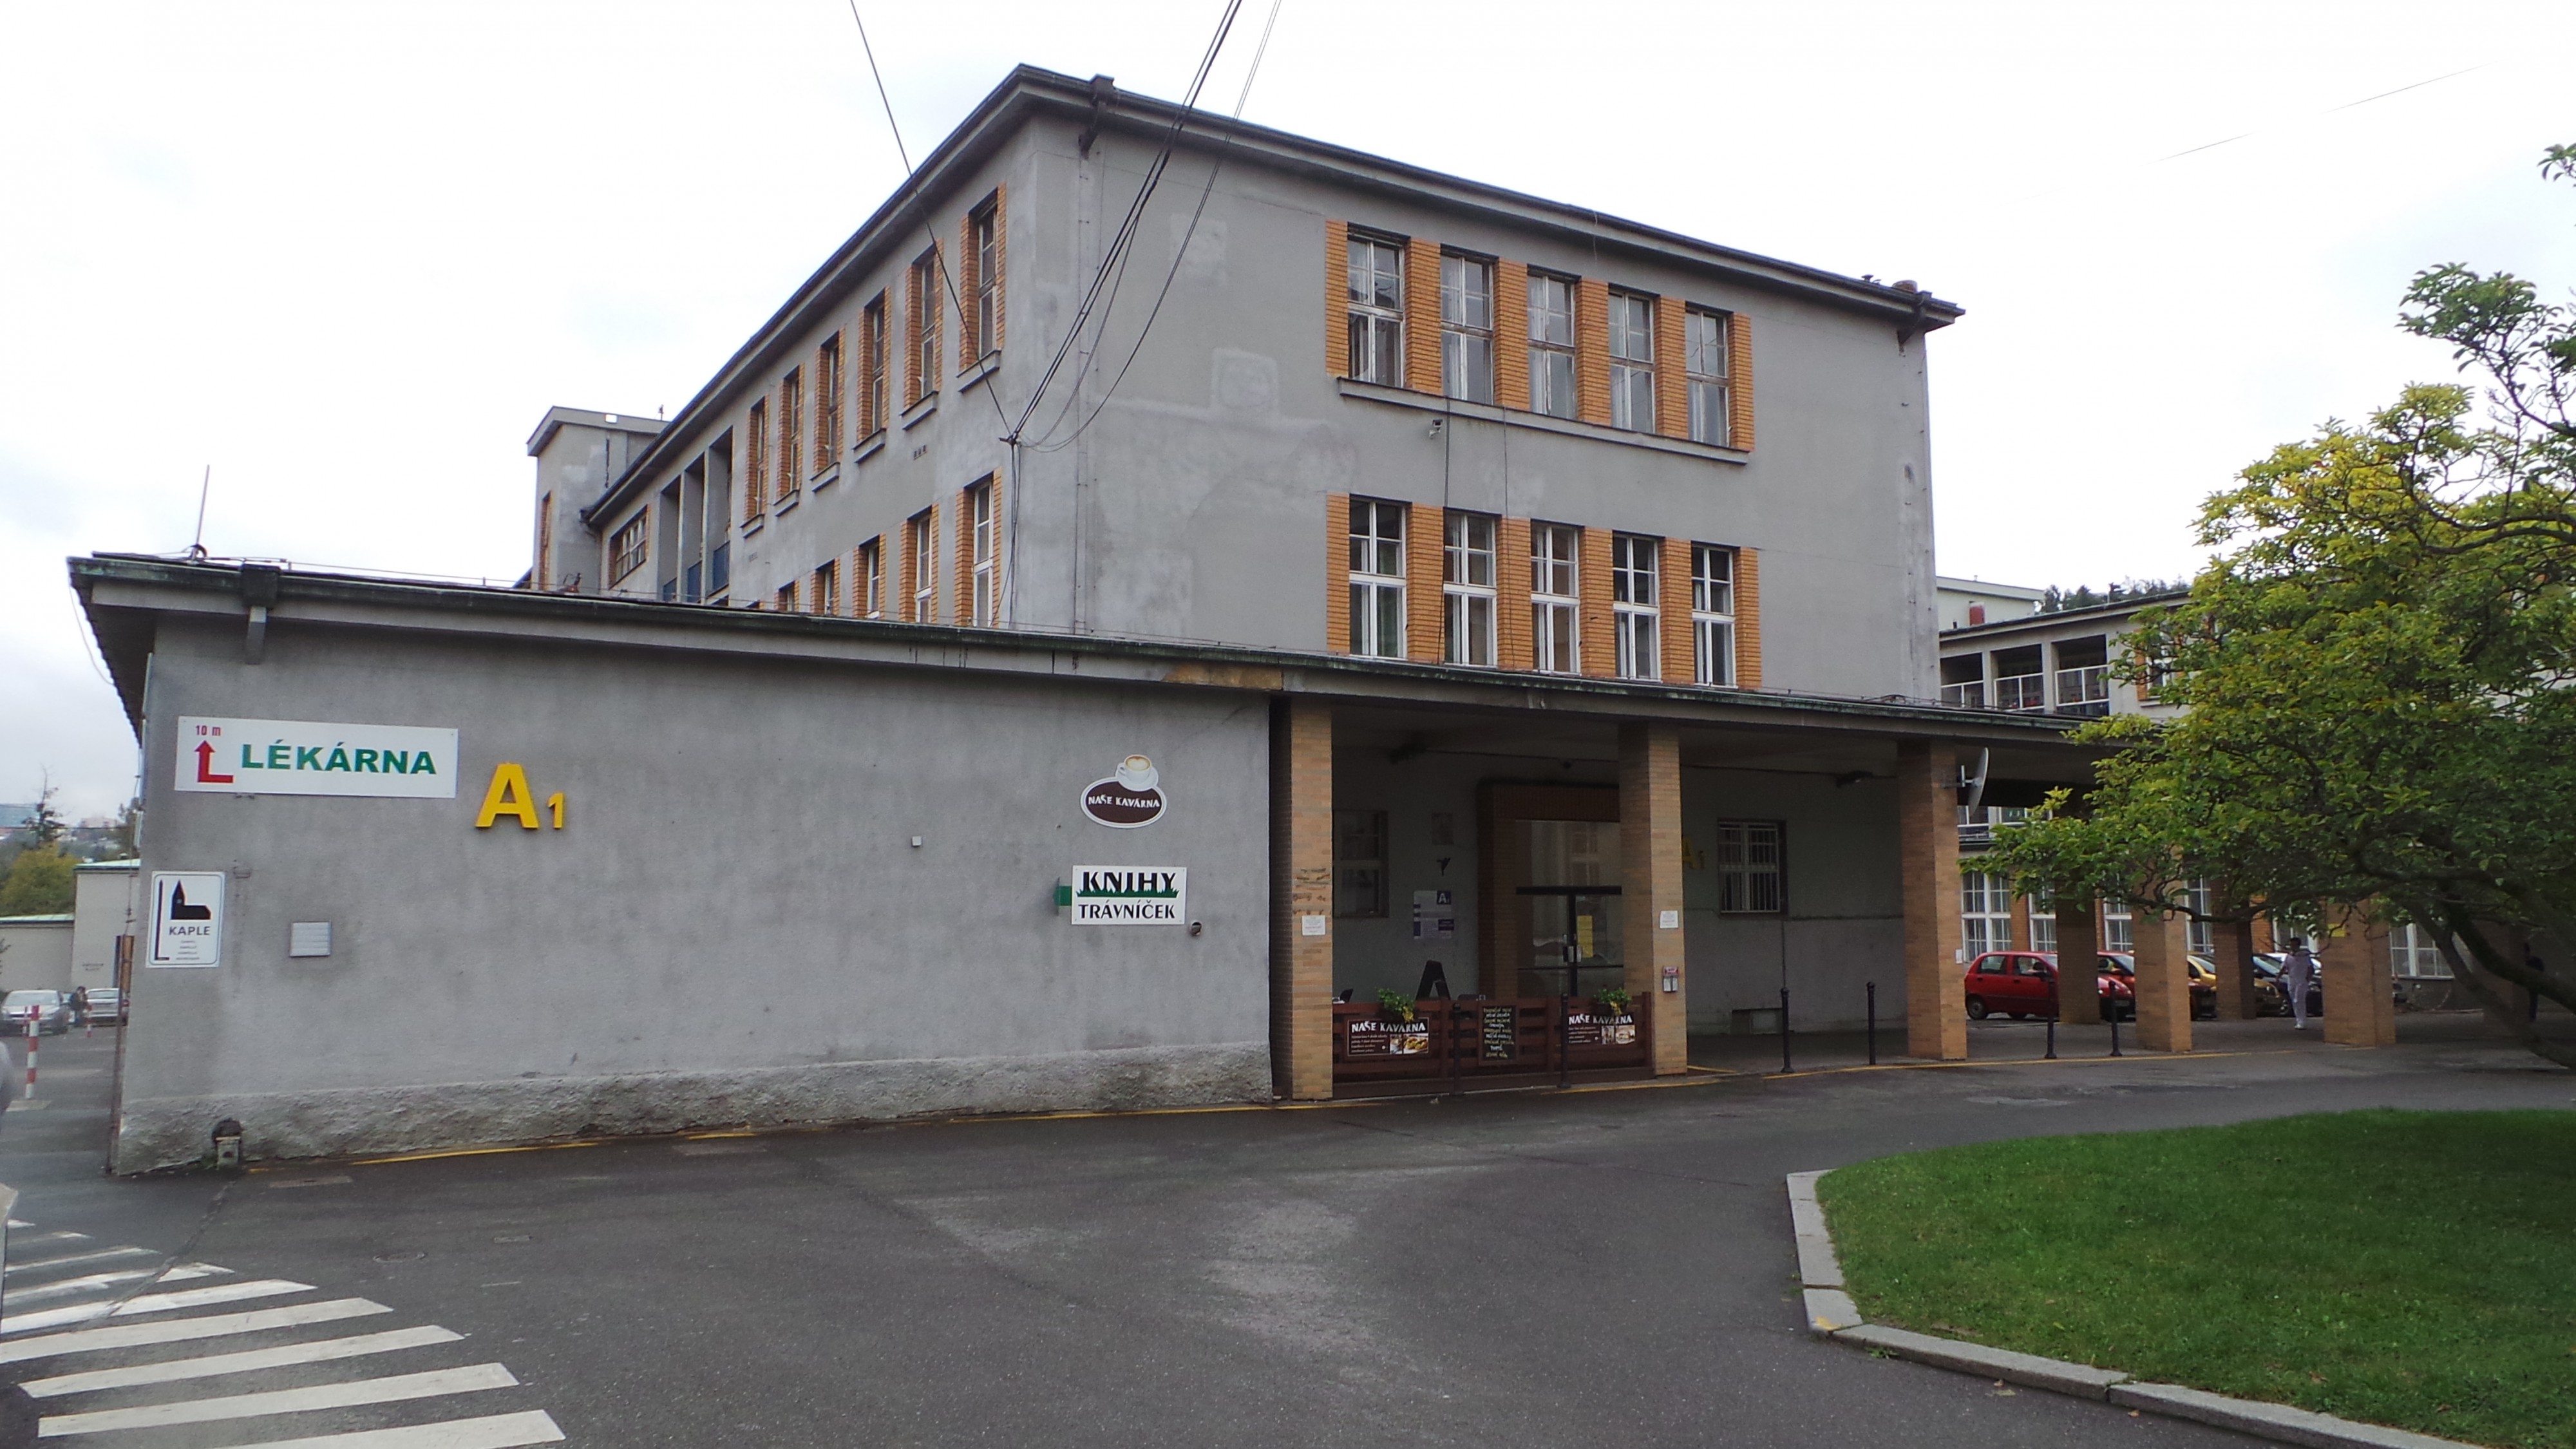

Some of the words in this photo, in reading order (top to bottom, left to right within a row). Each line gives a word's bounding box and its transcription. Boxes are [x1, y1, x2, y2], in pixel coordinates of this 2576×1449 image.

[196, 725, 207, 735] 10
[212, 726, 221, 736] m
[242, 739, 437, 774] LÉKÁRNA
[1088, 794, 1113, 805] NAŠE
[1115, 797, 1160, 808] KAVÁRNA
[1083, 871, 1176, 893] KNIHY
[1078, 900, 1175, 919] TRÁVNÍČEK
[169, 925, 211, 936] KAPLE
[1351, 1021, 1377, 1033] NAŠE
